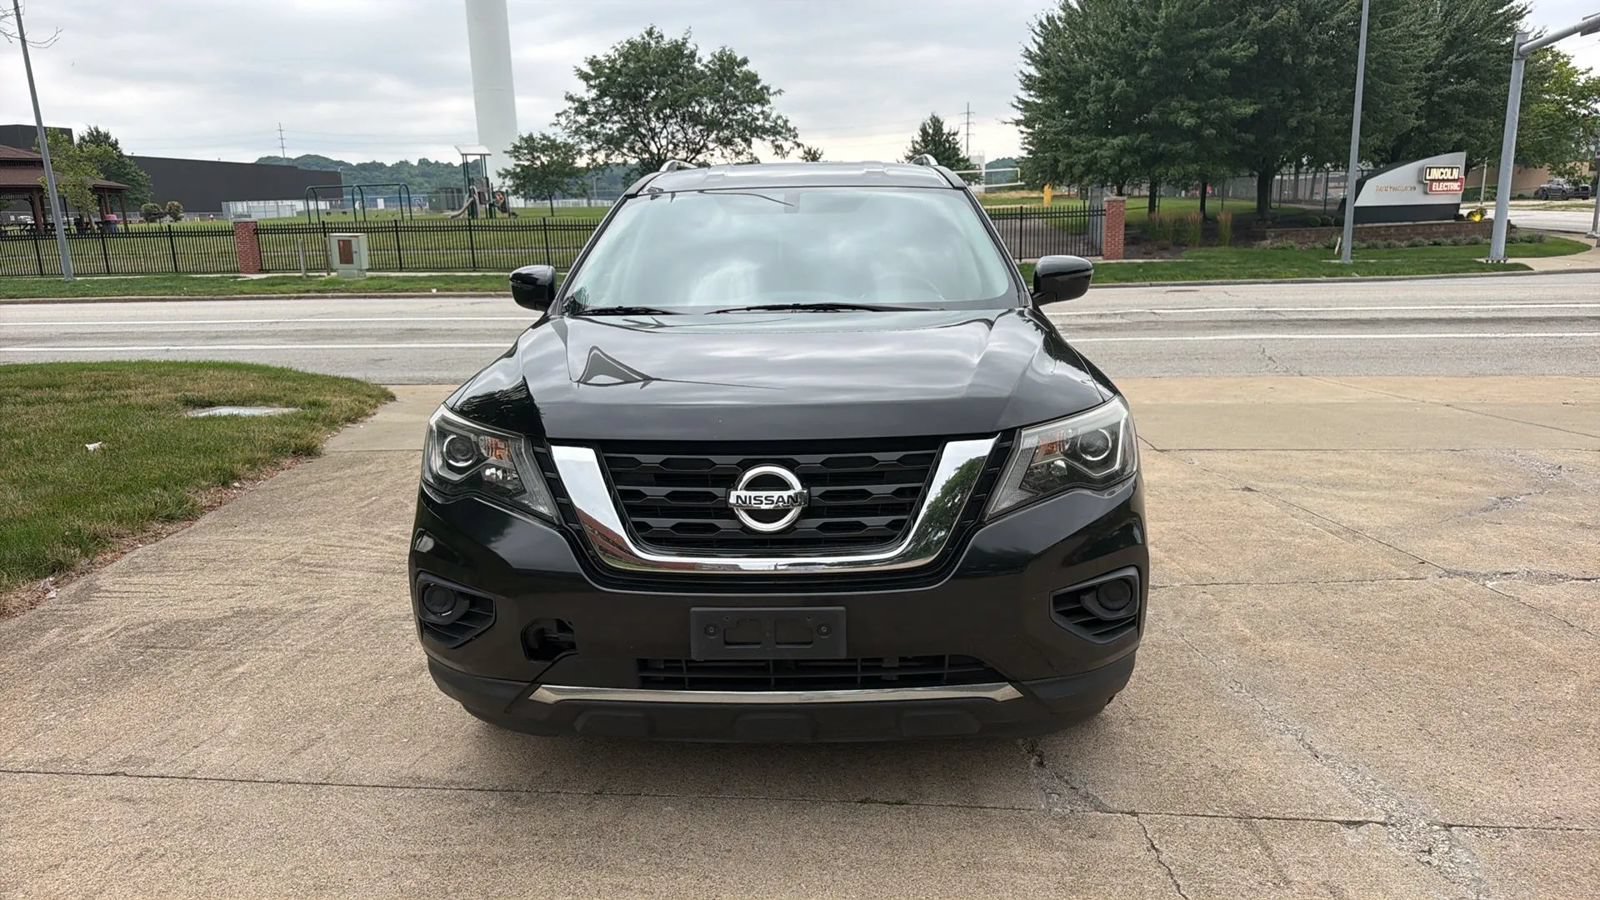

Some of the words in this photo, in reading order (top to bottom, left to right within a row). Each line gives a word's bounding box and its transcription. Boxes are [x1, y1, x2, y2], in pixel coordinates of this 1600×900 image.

[1426, 167, 1459, 180] LINCOLN
[1432, 182, 1461, 191] ELECTRIC
[735, 494, 799, 506] NISSAN
